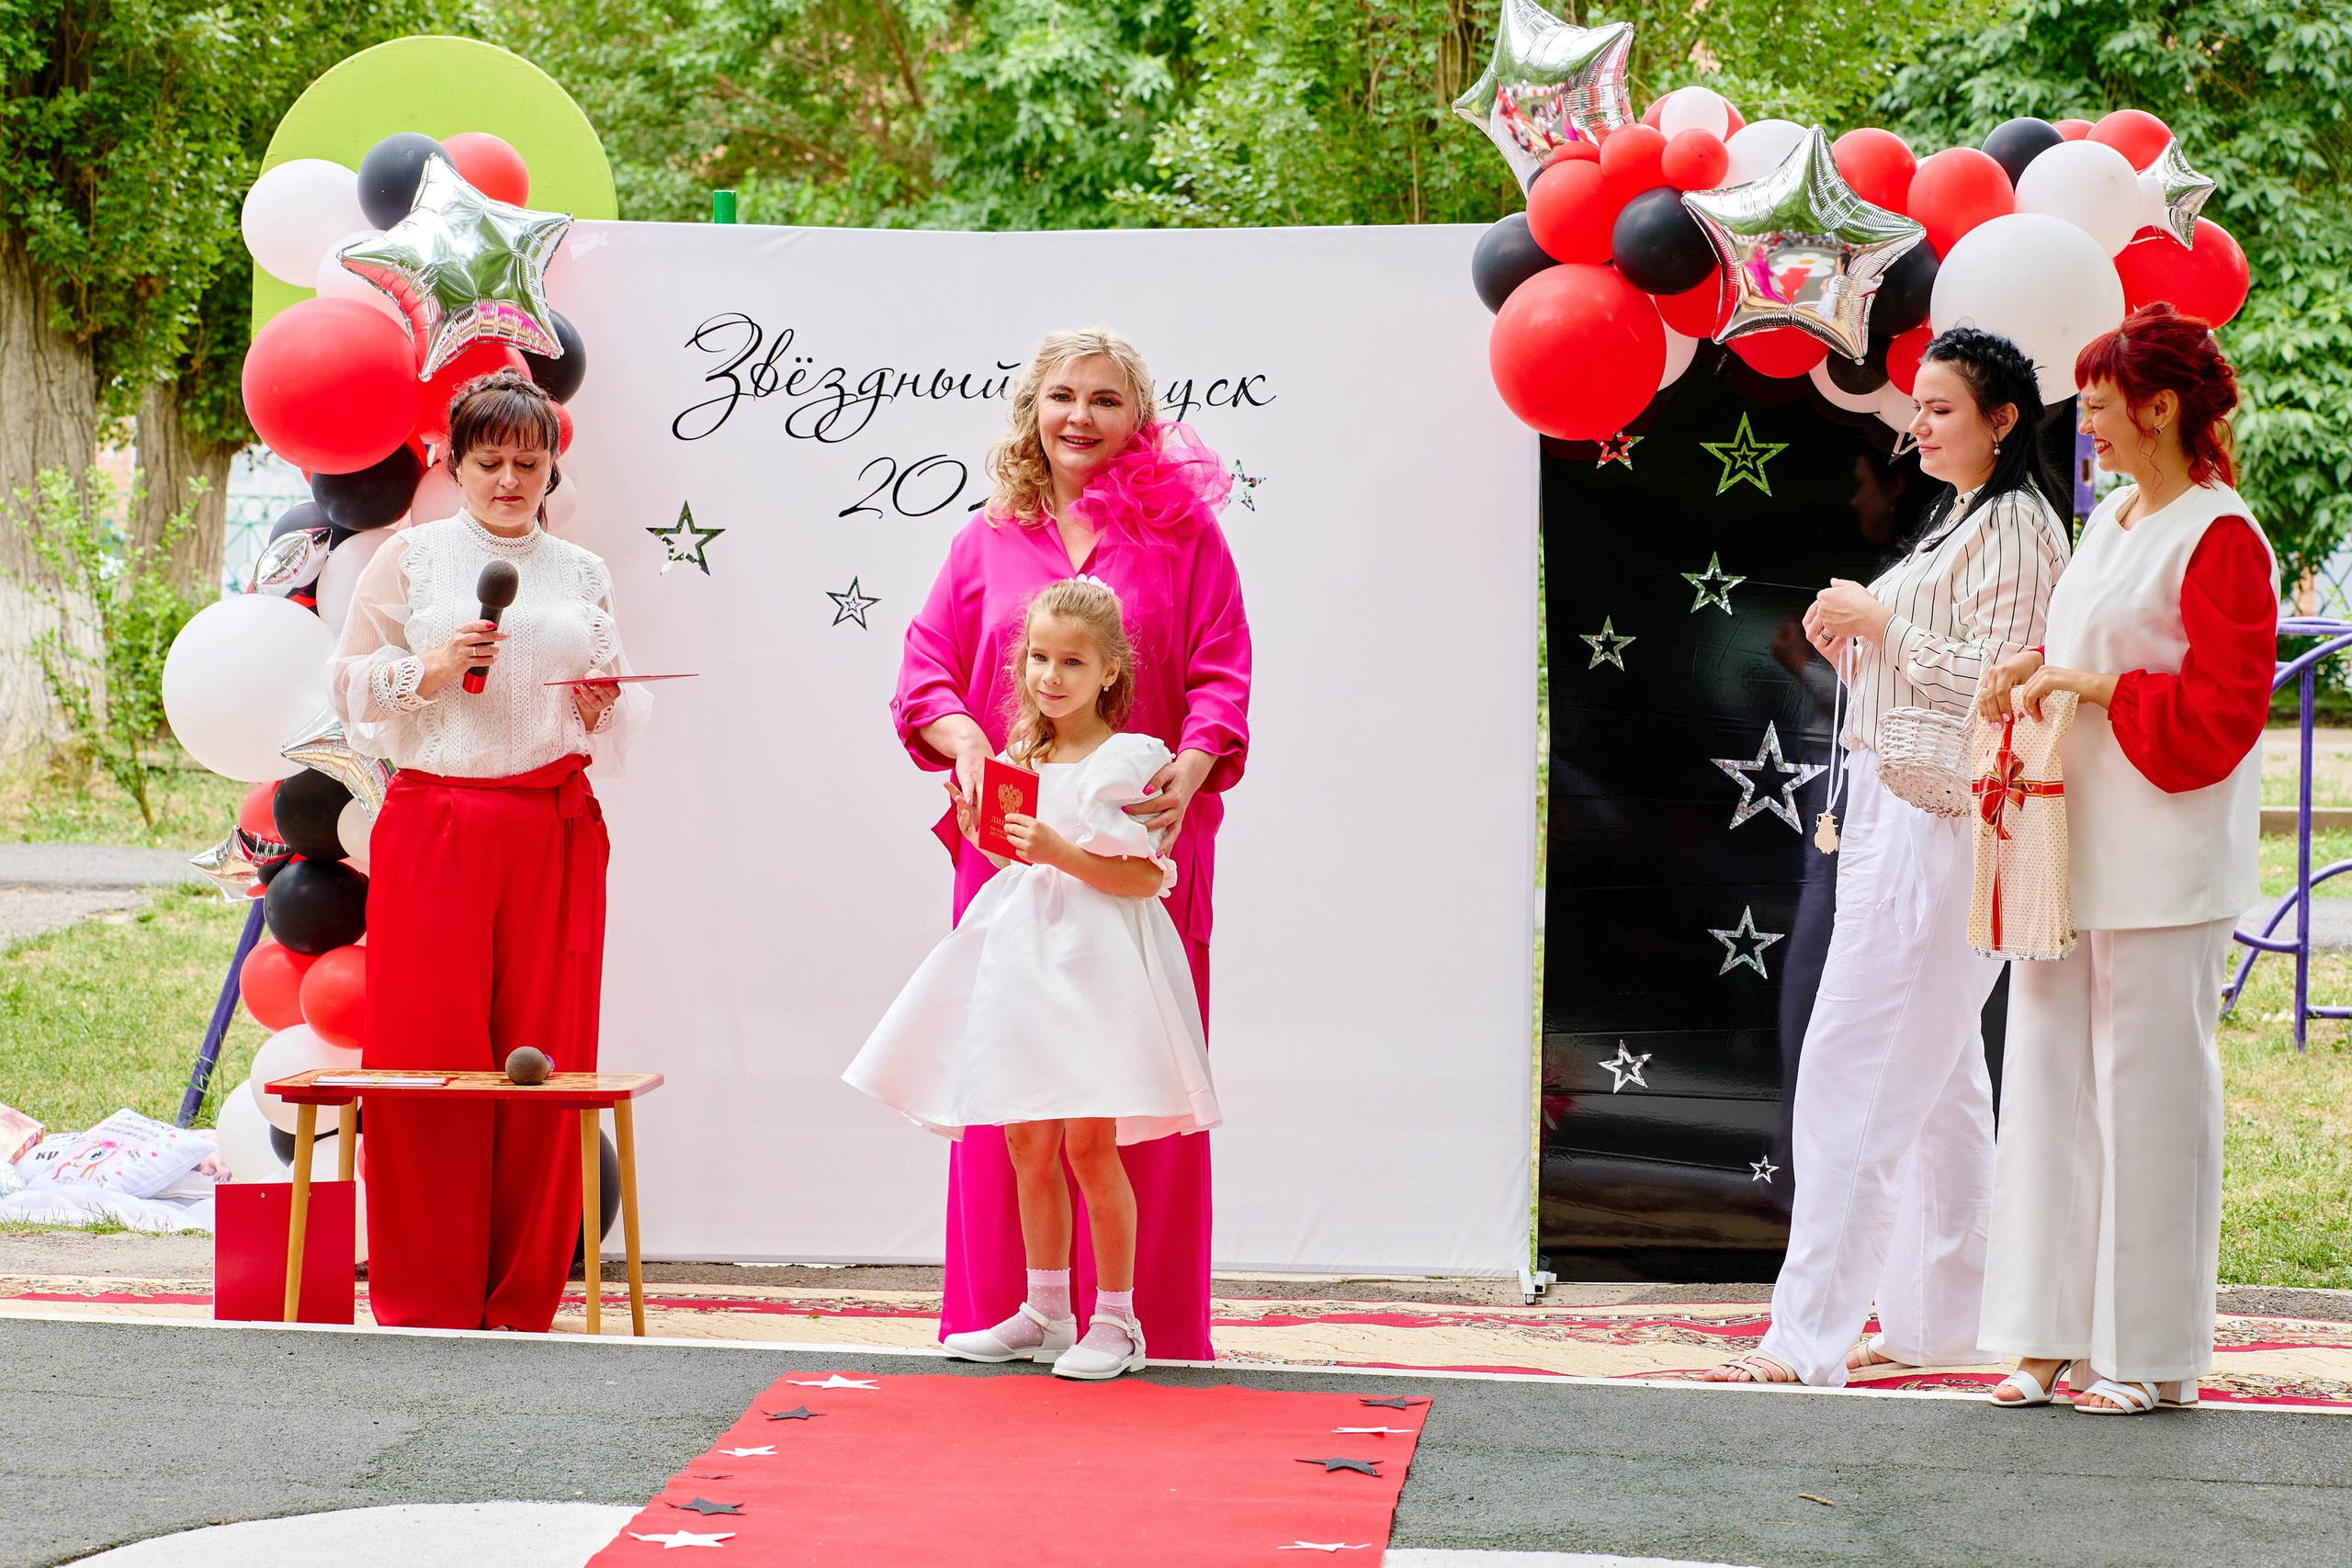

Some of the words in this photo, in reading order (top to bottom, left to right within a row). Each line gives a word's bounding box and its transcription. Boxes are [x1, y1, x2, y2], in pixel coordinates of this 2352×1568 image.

[672, 311, 1022, 444] Звёздный
[1151, 374, 1278, 436] уск
[838, 454, 990, 520] 20
[990, 815, 1008, 827] ДИП
